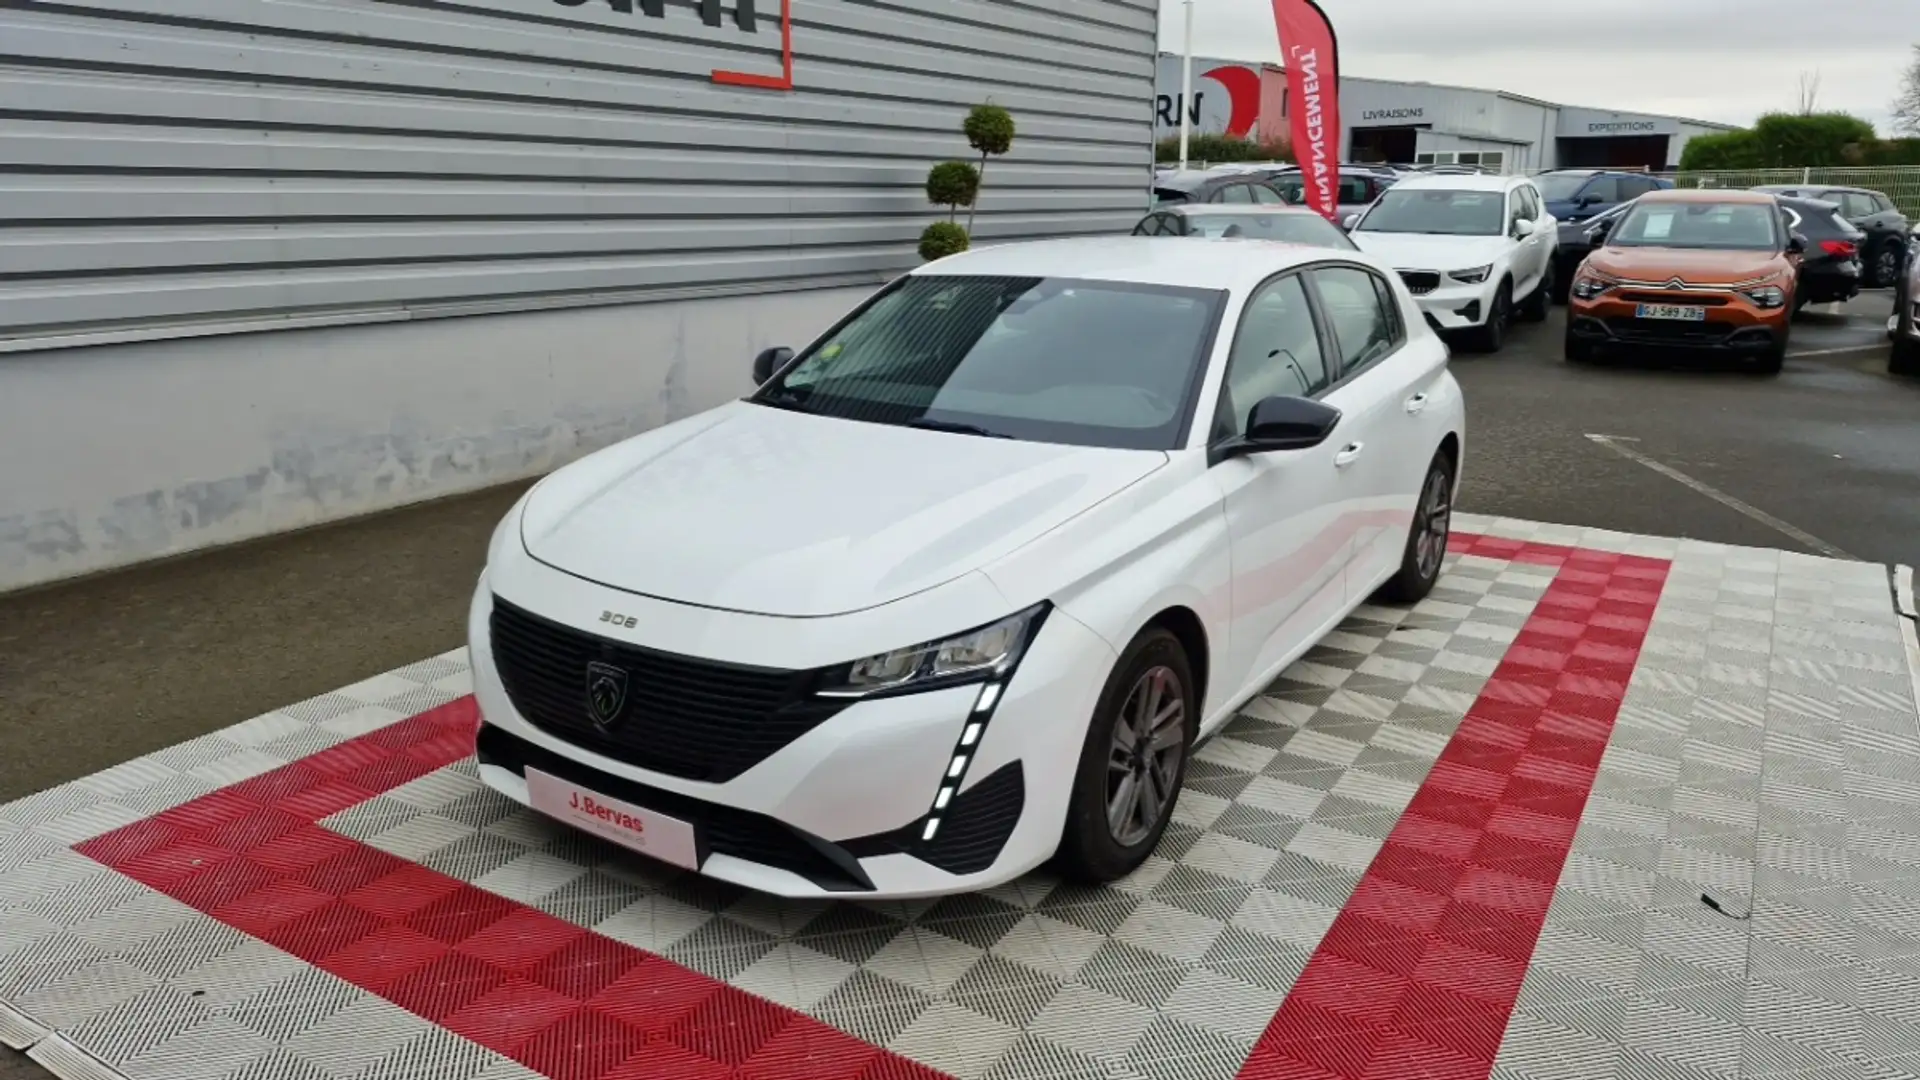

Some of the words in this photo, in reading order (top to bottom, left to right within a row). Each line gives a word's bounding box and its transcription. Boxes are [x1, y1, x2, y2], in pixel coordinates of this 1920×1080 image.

[1362, 107, 1424, 120] LIVRAISONS
[1588, 121, 1654, 132] EXPEDITIONS
[599, 610, 638, 628] 308
[569, 791, 643, 832] J.Bervas
